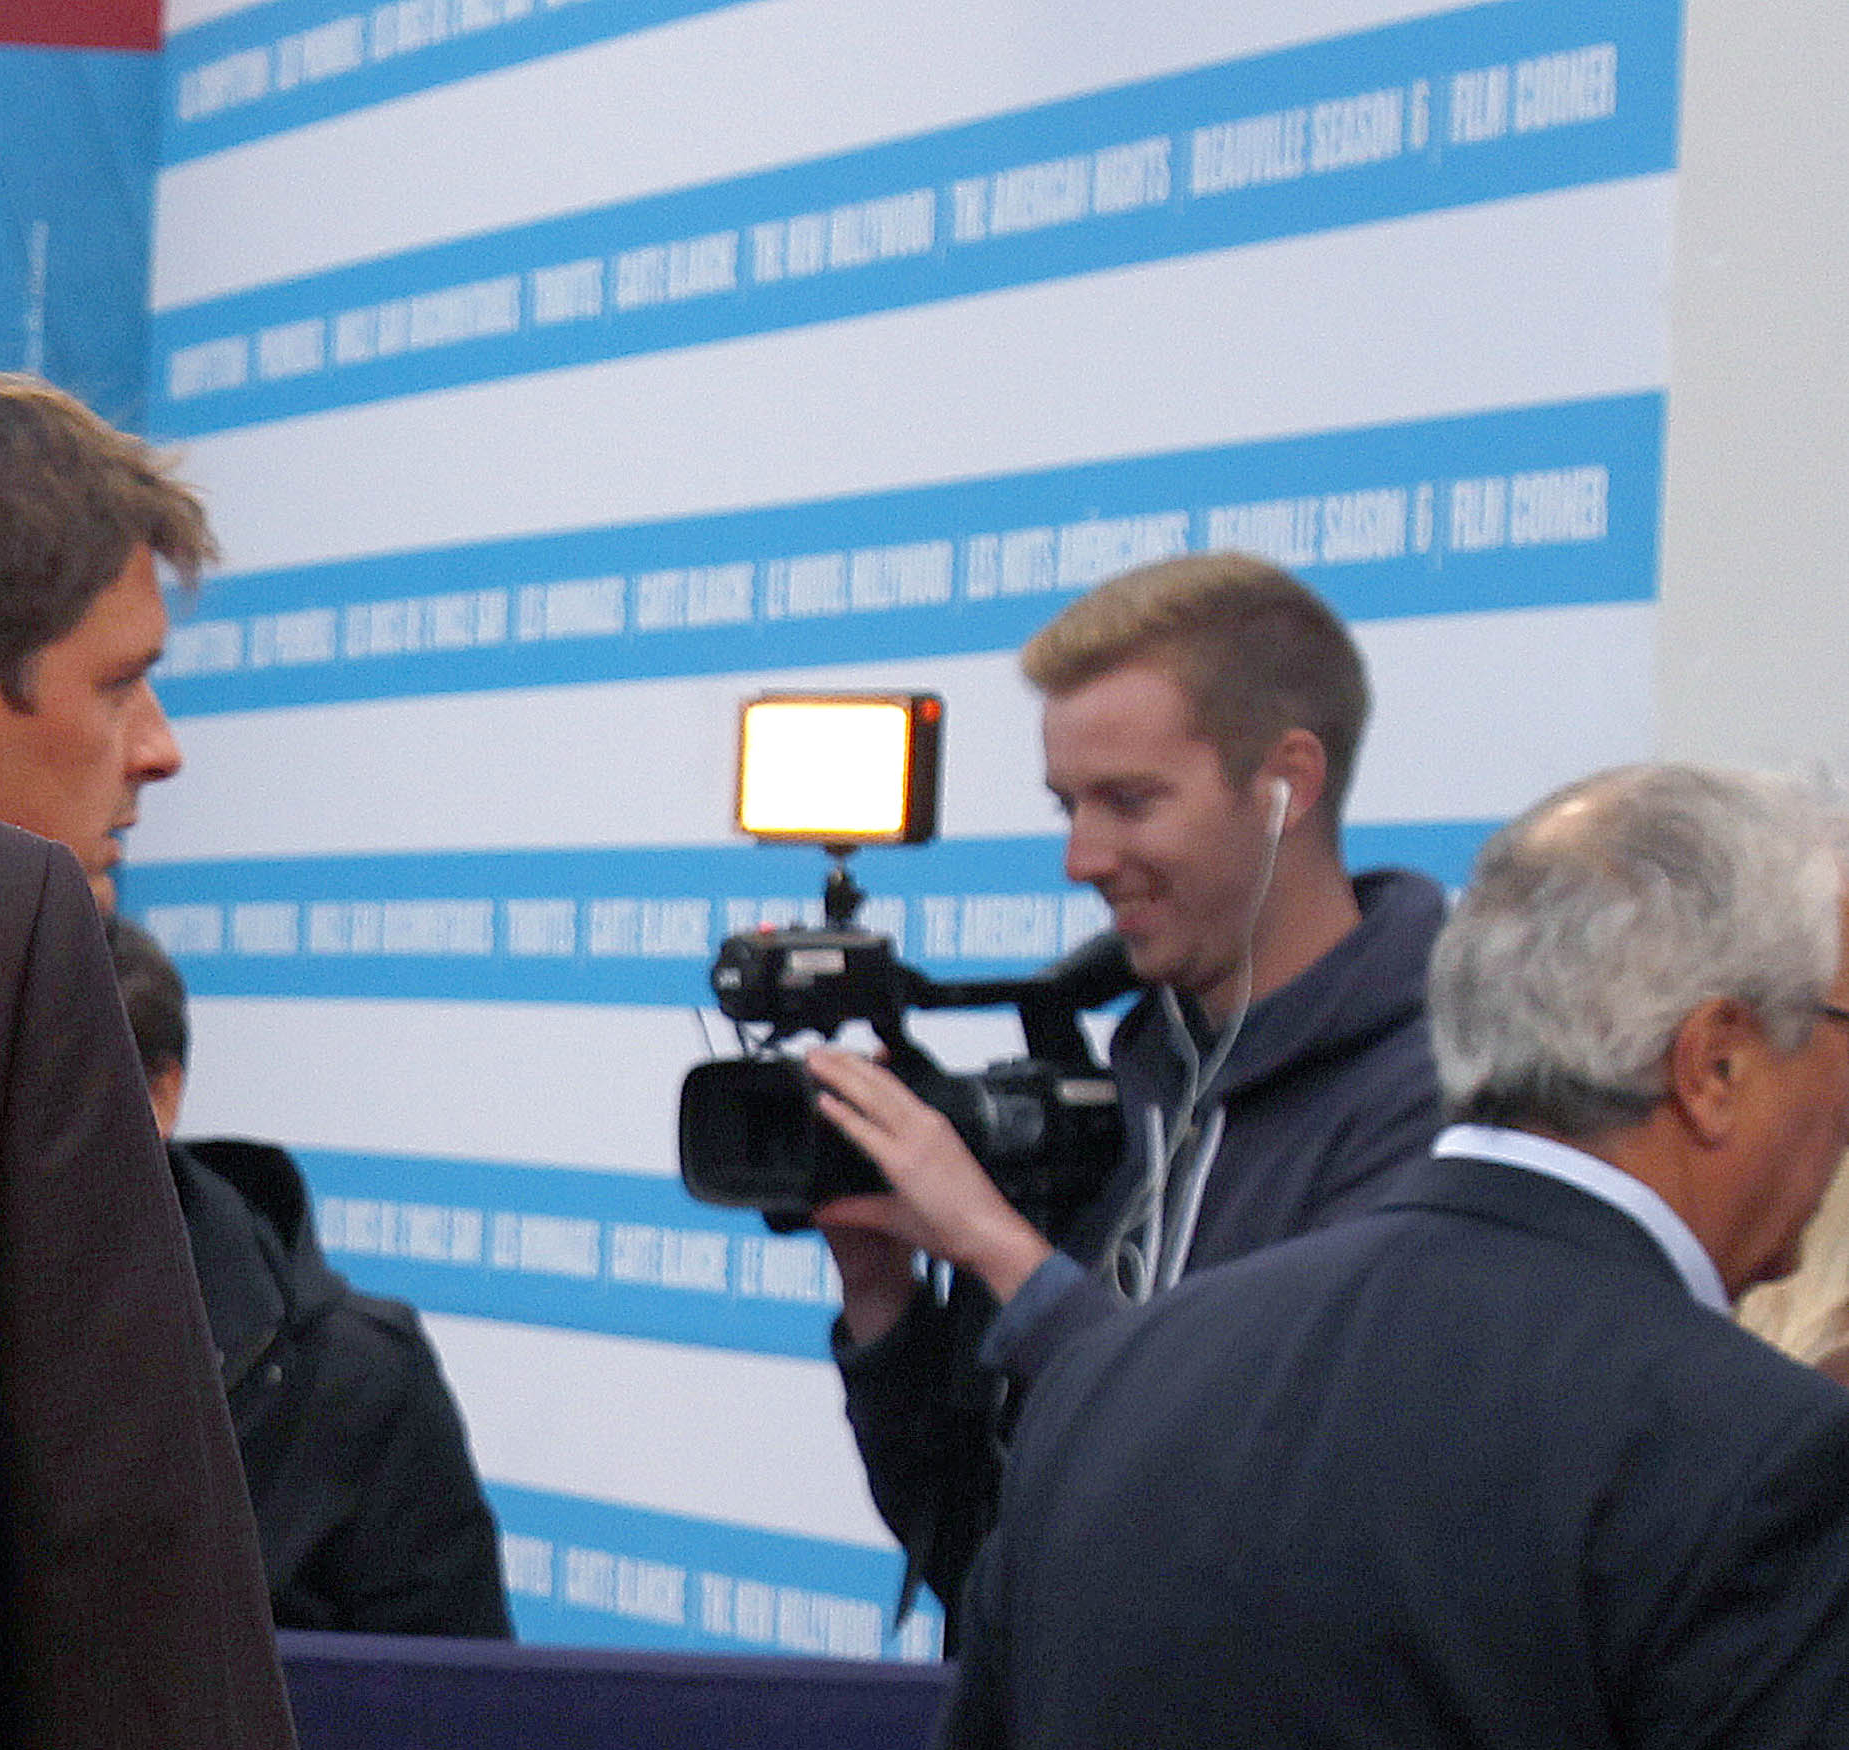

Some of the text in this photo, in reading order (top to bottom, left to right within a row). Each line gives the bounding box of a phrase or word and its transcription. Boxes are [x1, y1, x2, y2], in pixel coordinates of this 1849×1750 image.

[1309, 88, 1404, 173] SEASON
[1449, 43, 1618, 144] FILM CORNER
